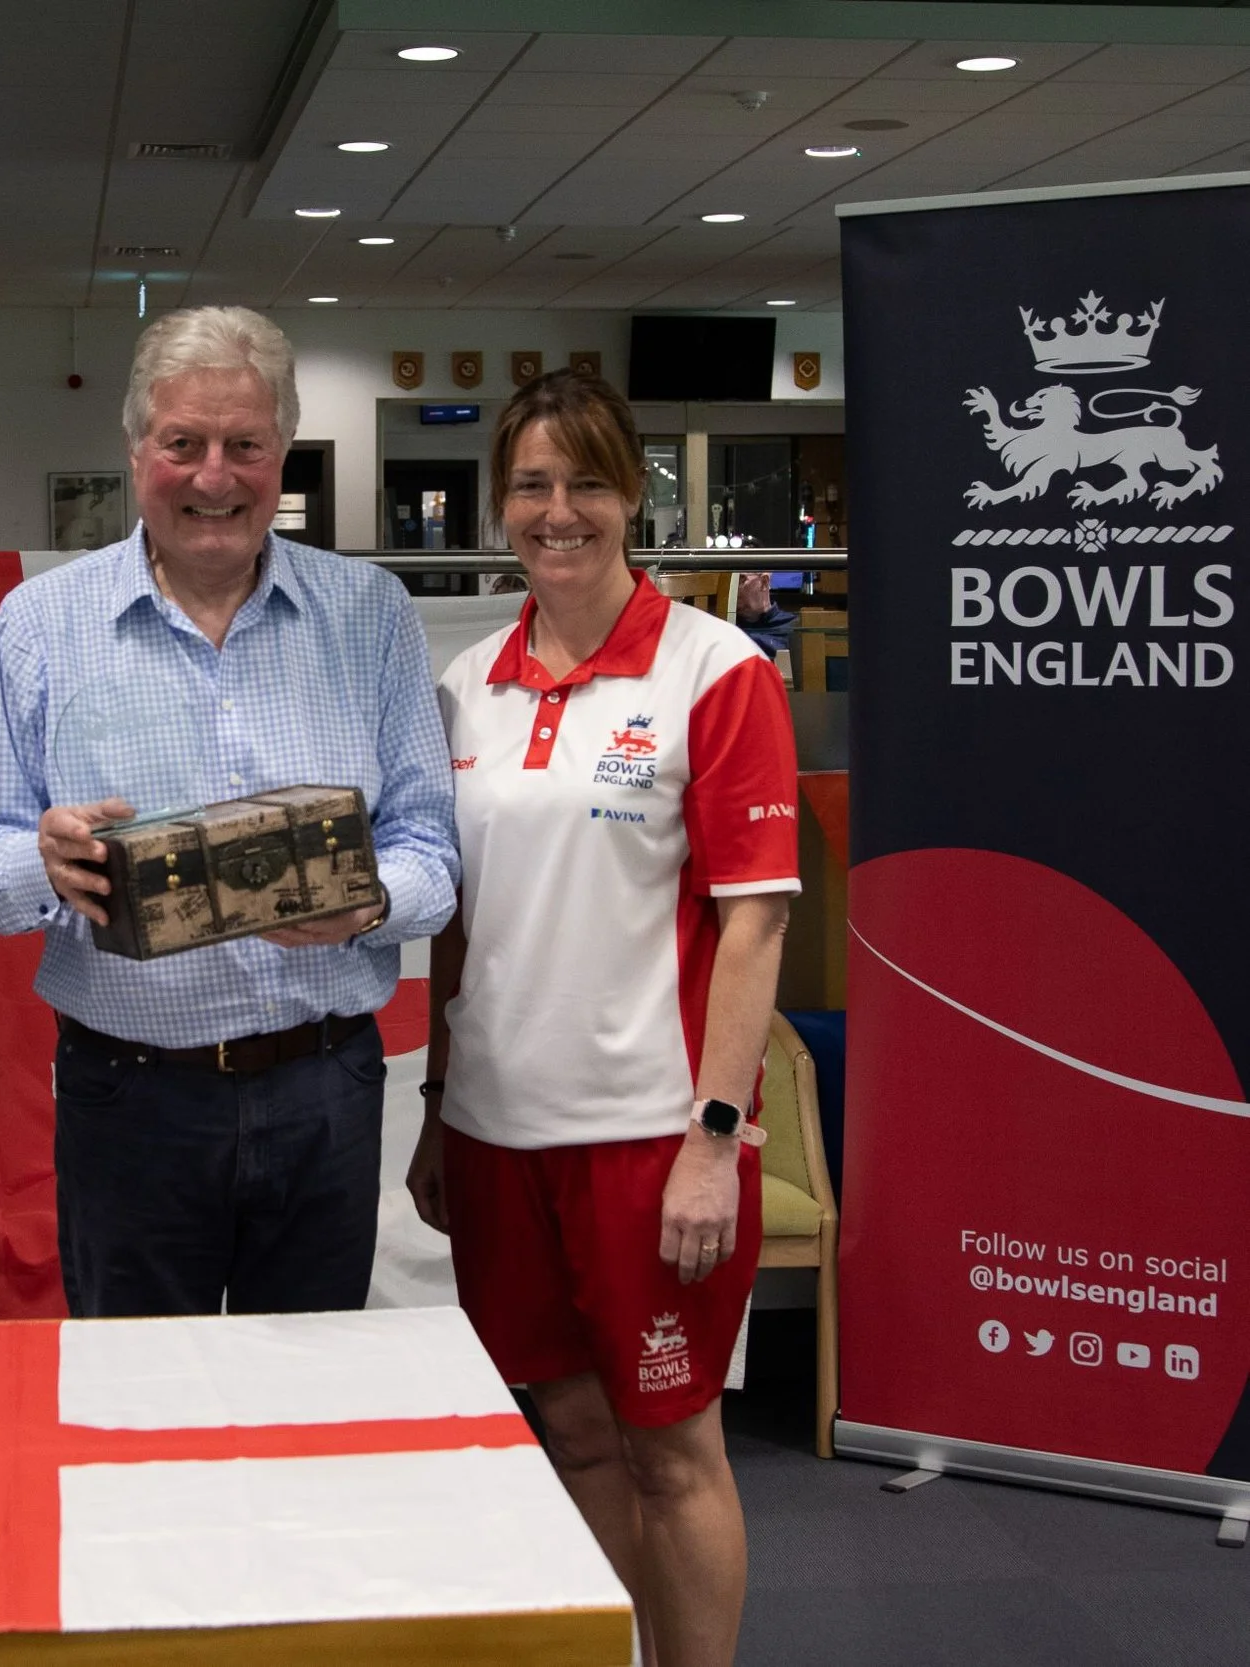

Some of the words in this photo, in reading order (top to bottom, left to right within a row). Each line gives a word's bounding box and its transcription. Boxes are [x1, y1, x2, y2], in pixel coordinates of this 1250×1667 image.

[950, 564, 1235, 627] BOWLS
[950, 641, 1234, 687] ENGLAND
[596, 760, 656, 777] BOWLS
[593, 774, 654, 789] ENGLAND
[603, 809, 646, 823] AVIVA
[960, 1229, 1046, 1261] Follow
[1057, 1246, 1089, 1266] us
[1099, 1251, 1134, 1272] on
[1145, 1257, 1228, 1283] social
[969, 1265, 1218, 1317] @bowlsengland
[638, 1357, 690, 1381] BOWLS
[639, 1372, 691, 1393] ENGLAND
